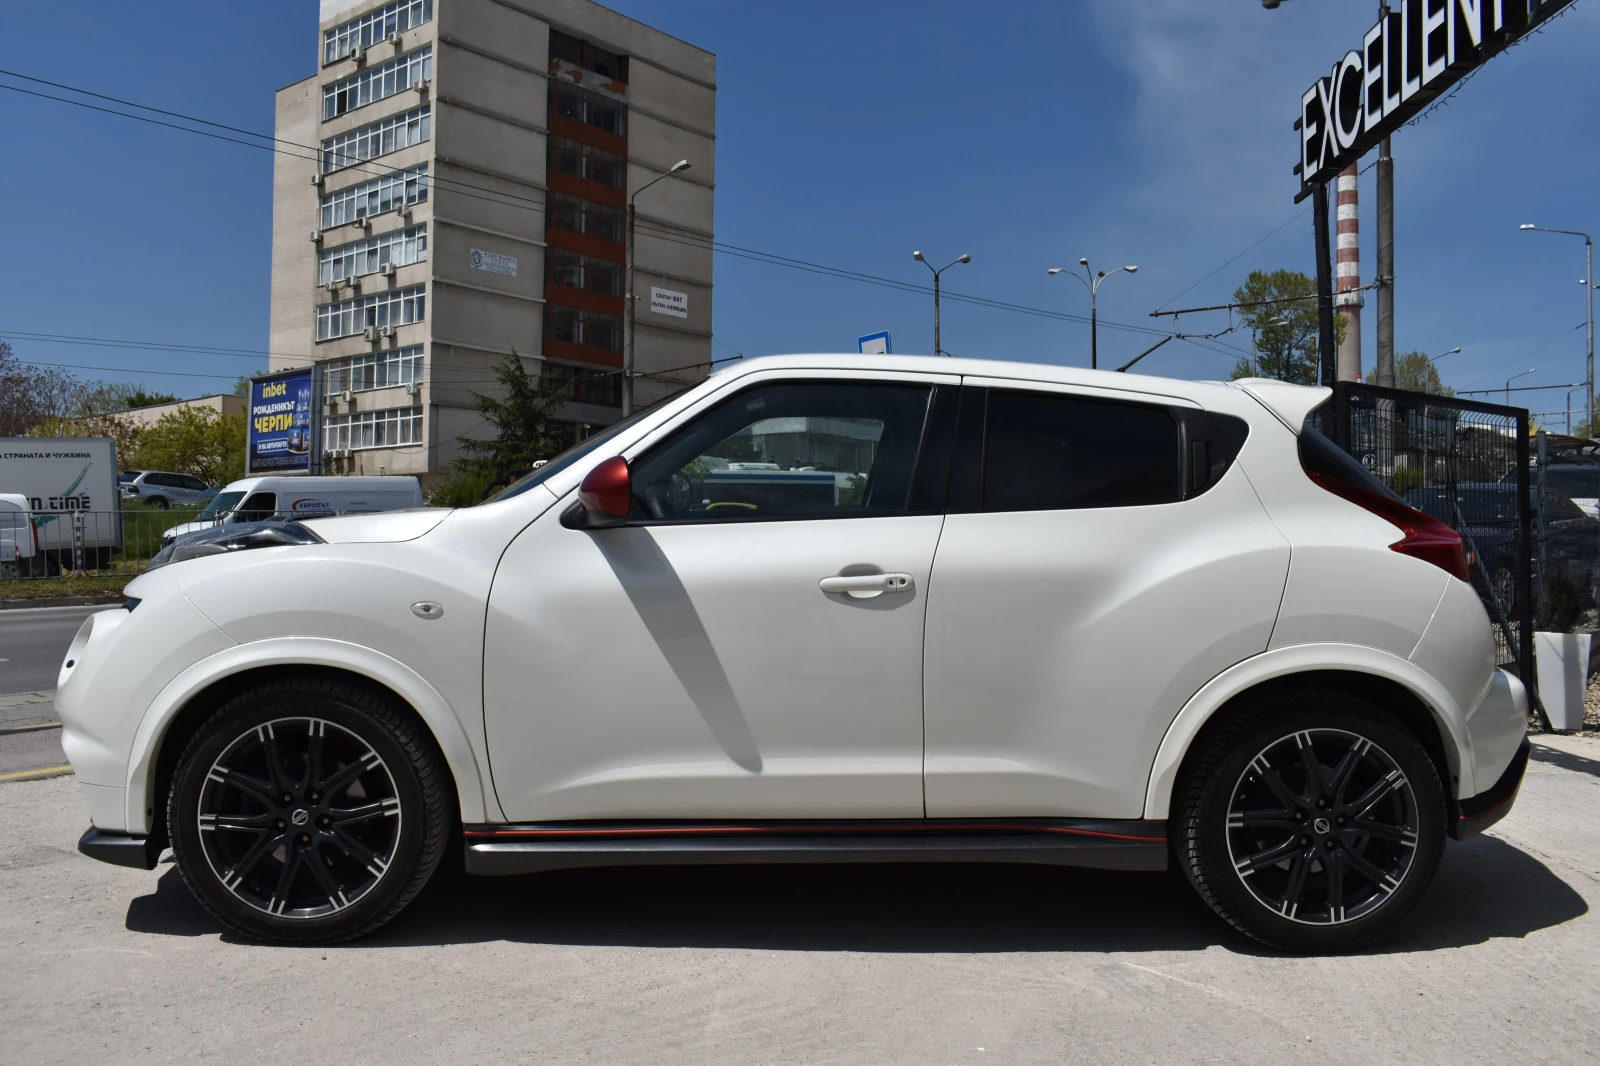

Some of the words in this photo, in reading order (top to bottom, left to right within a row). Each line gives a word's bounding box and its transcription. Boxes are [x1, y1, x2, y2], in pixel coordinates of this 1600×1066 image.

[655, 292, 672, 300] СЕКТОР
[672, 295, 683, 303] КАТ
[263, 381, 286, 398] inbet
[253, 401, 295, 415] РОЖДЕНИКЪТ
[254, 413, 292, 433] ЧЕРПИ
